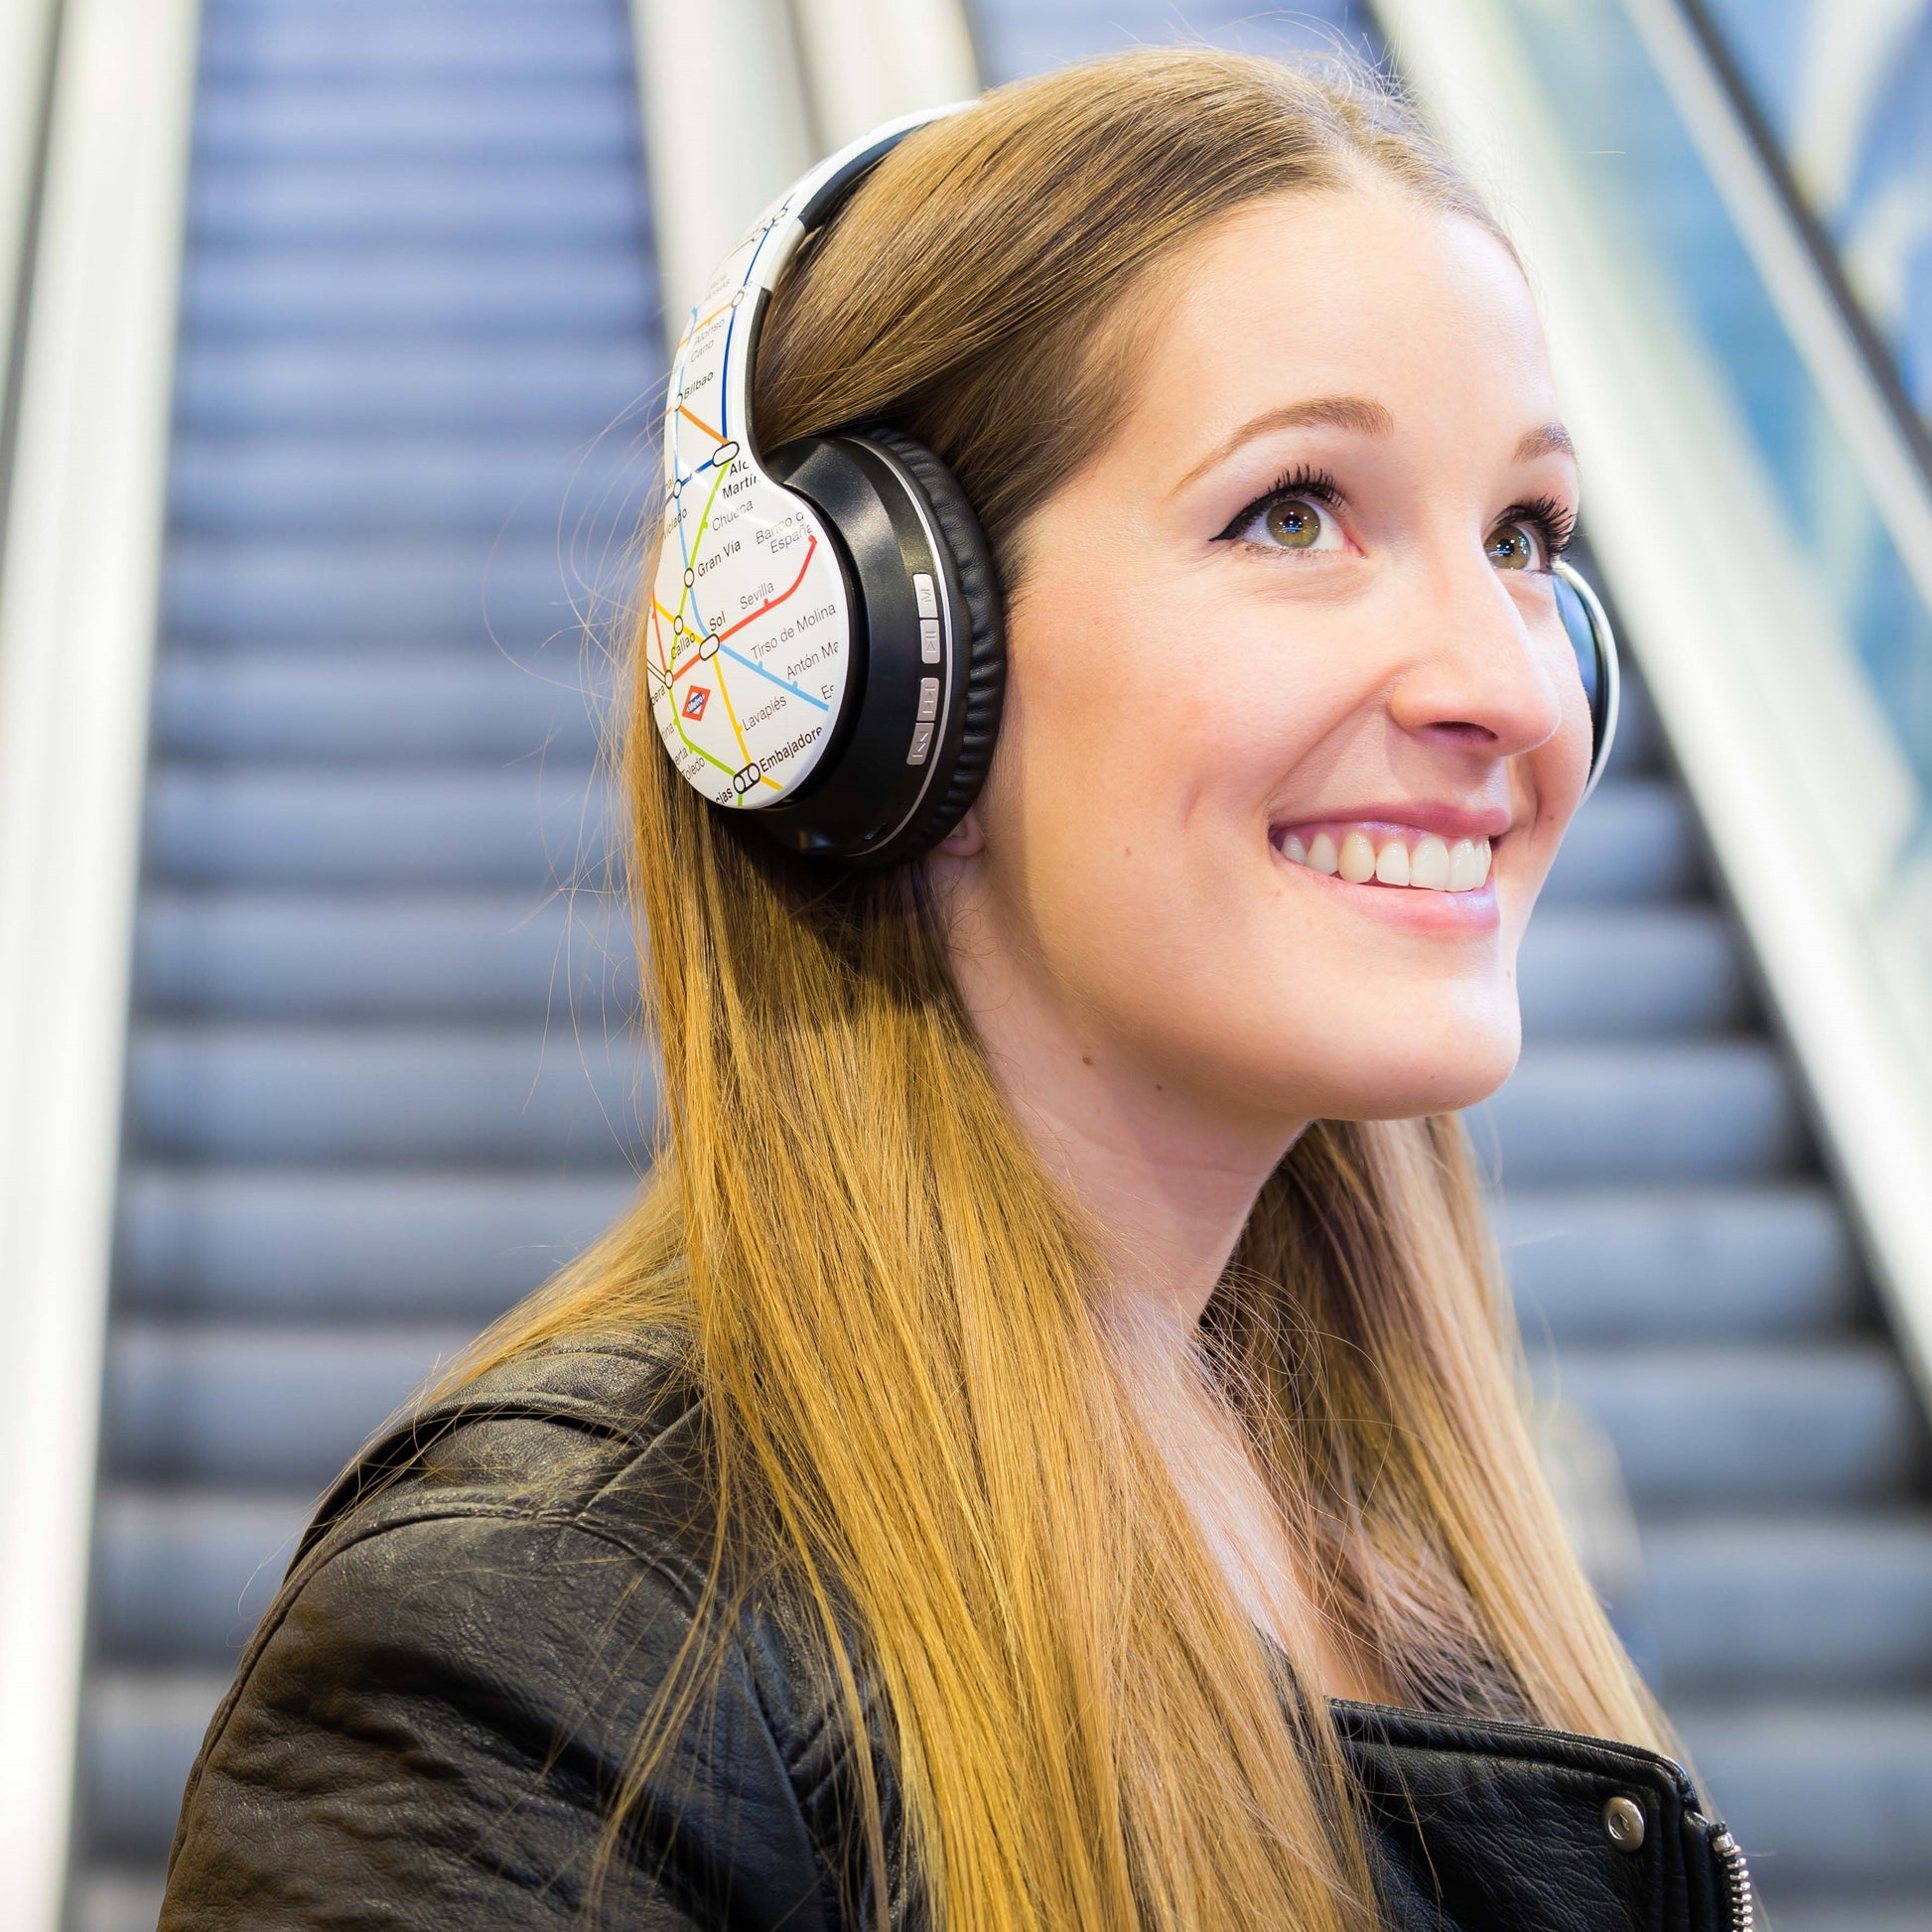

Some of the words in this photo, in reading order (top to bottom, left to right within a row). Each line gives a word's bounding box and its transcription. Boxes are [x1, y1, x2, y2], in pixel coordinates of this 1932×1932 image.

[683, 371, 714, 399] Bilbao
[698, 554, 722, 577] Gran
[740, 581, 774, 611] Sevilla
[709, 611, 726, 631] Sol
[751, 636, 778, 660] Tirso
[780, 626, 795, 642] de
[796, 604, 837, 633] Molina
[671, 632, 696, 660] Callao
[787, 652, 820, 681] Antón
[742, 696, 787, 731] Lavapiés
